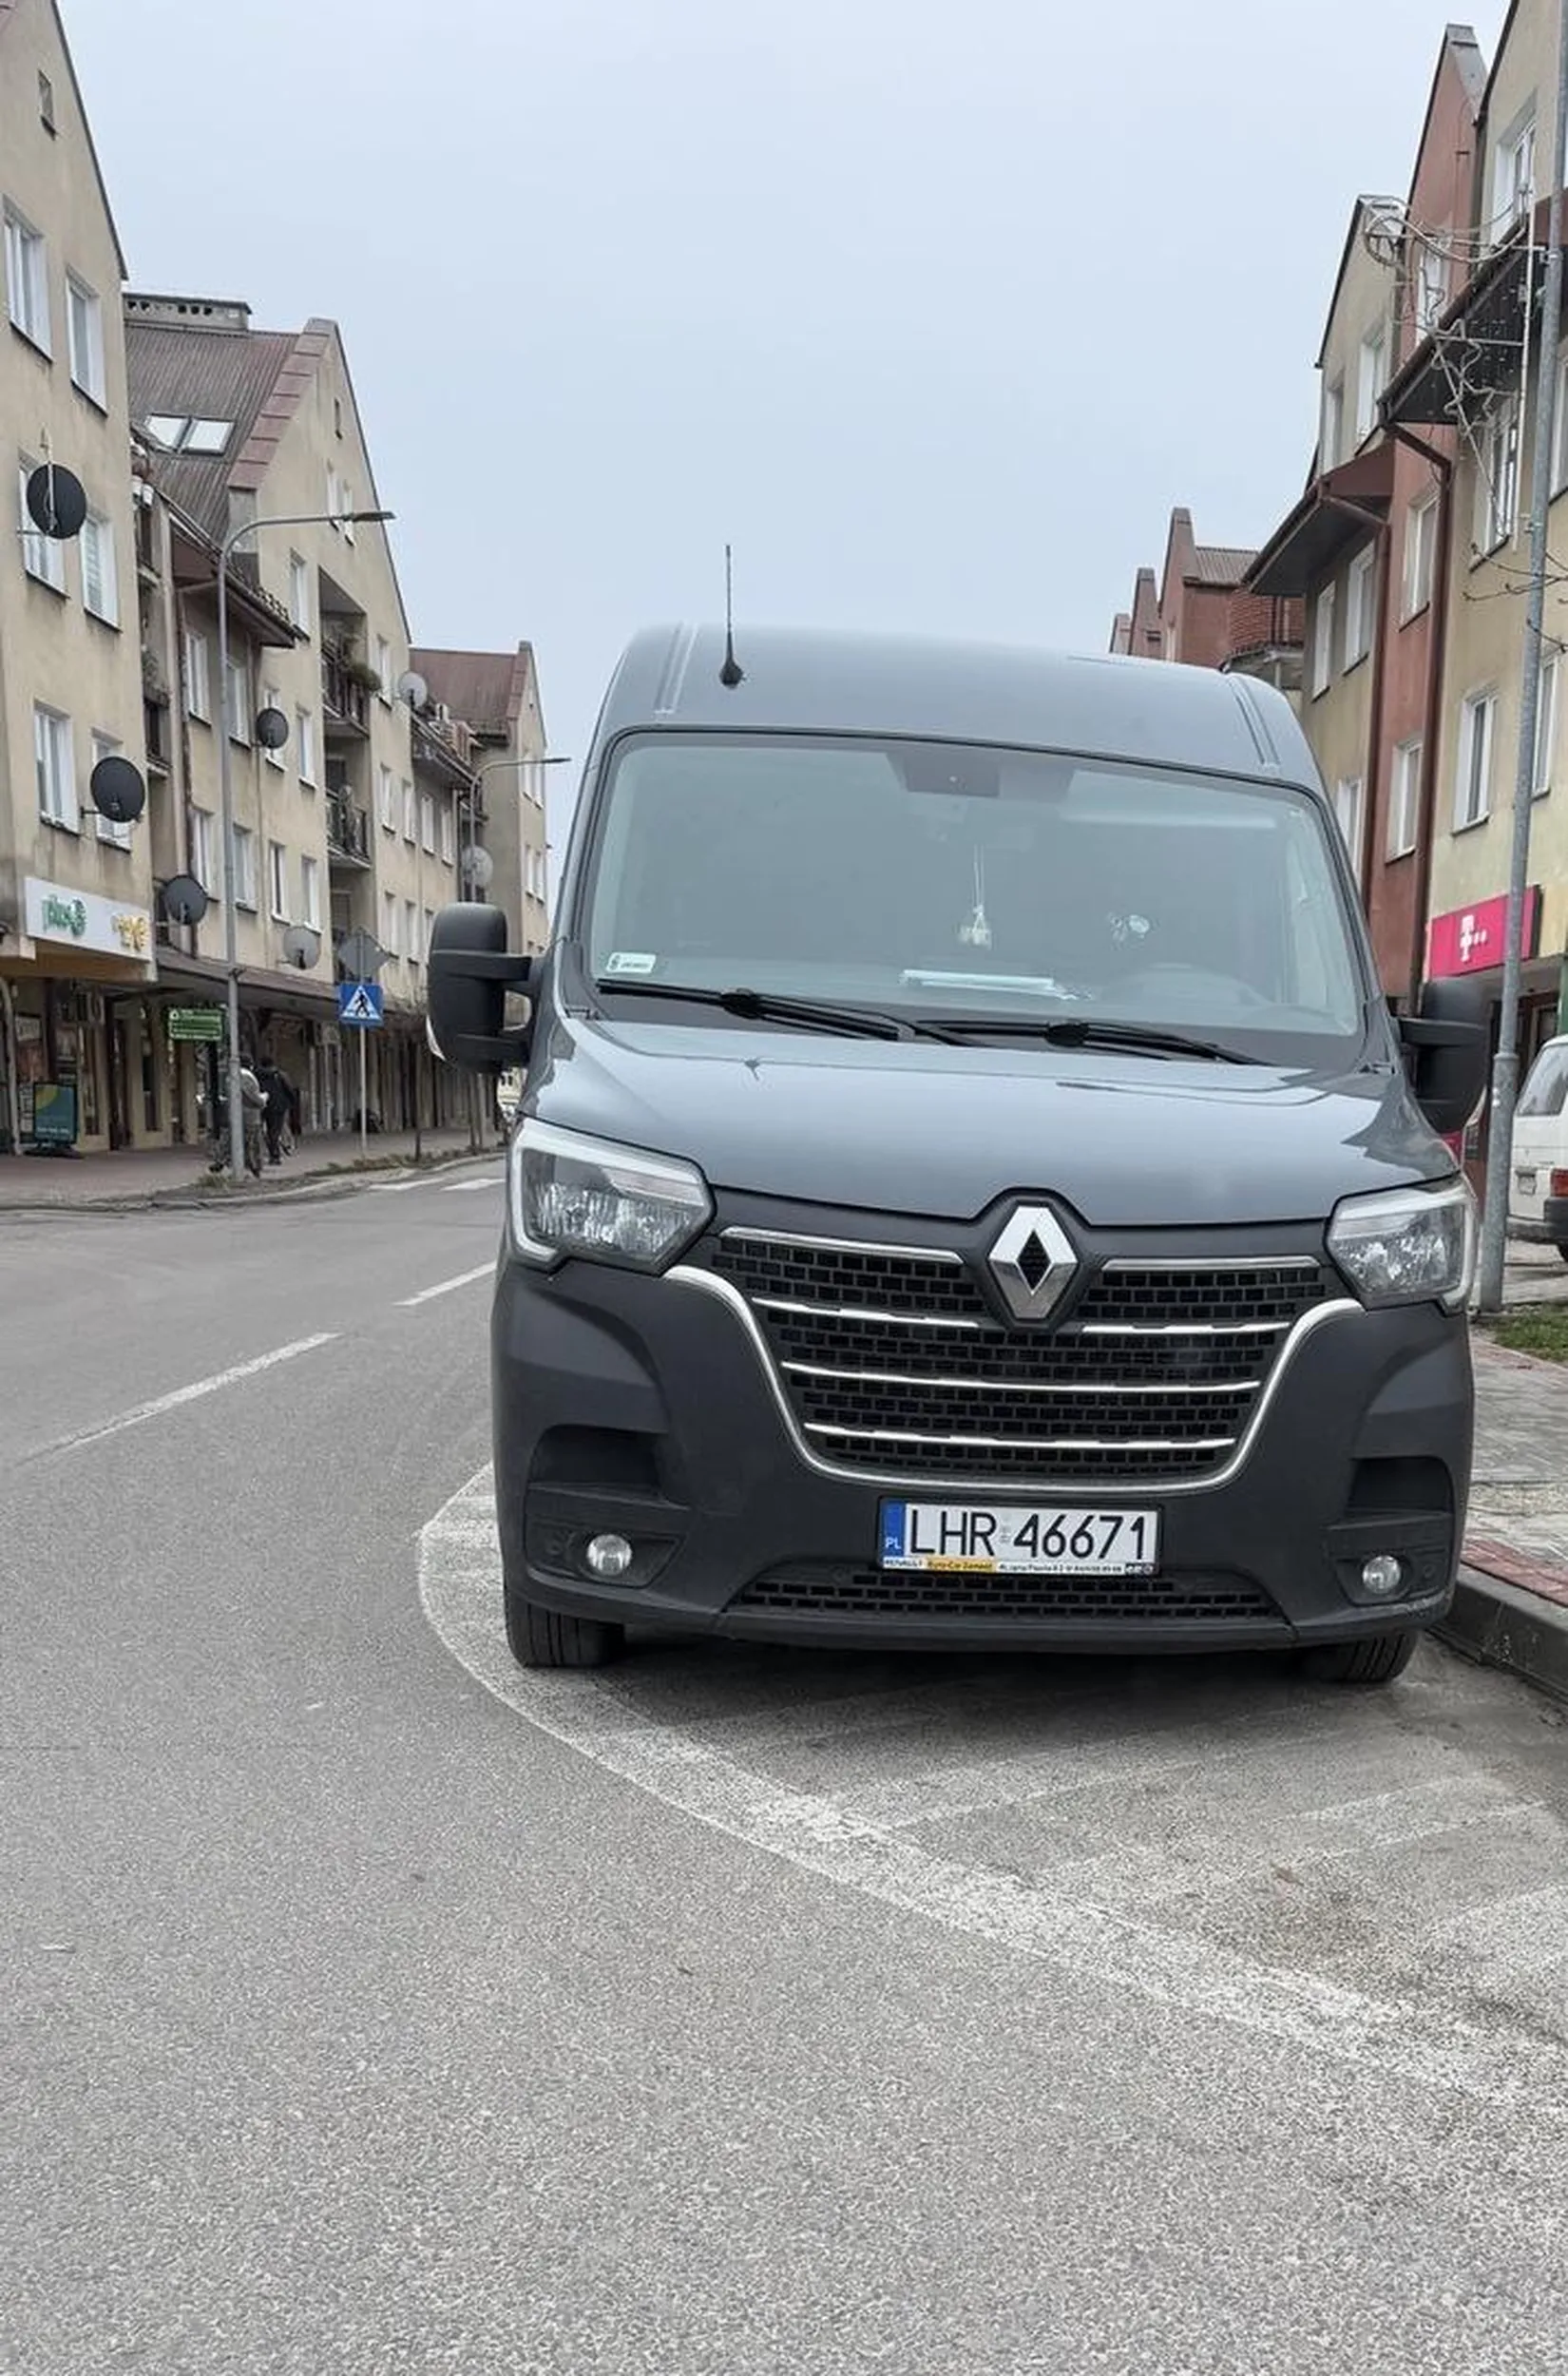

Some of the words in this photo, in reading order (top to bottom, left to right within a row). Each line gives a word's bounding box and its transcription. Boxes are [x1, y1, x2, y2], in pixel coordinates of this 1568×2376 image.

[885, 1537, 902, 1550] PL
[909, 1509, 994, 1556] LHR
[1013, 1514, 1145, 1560] 46671
